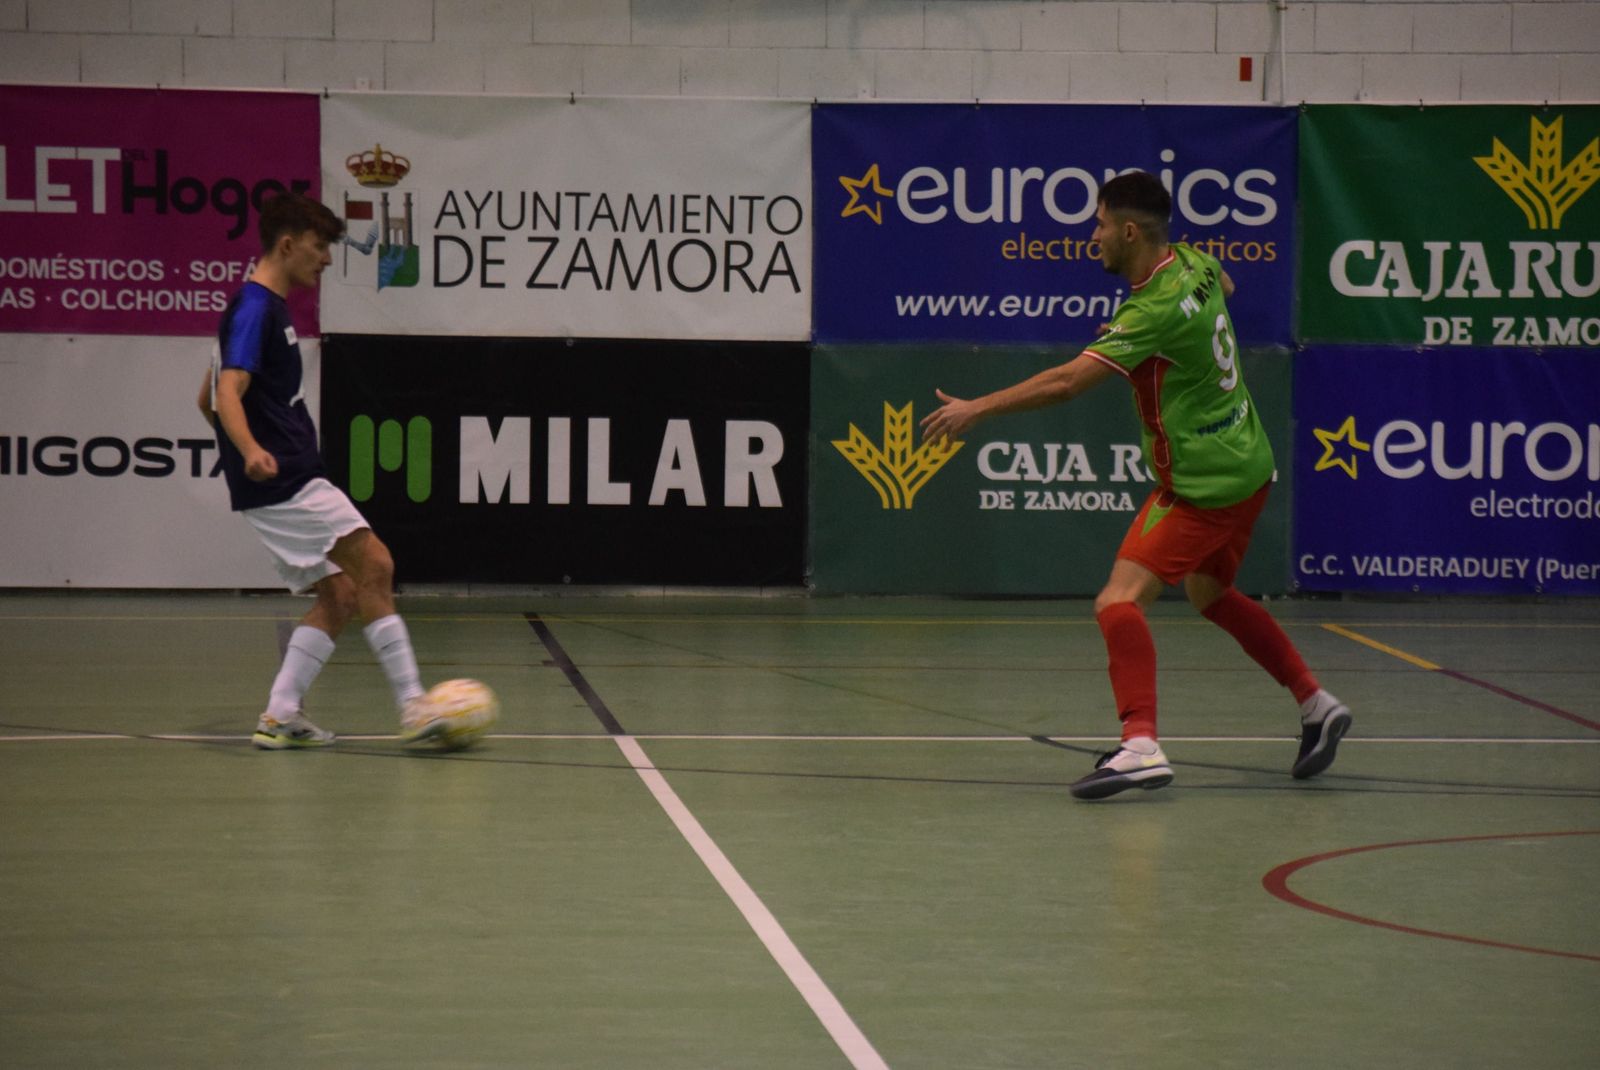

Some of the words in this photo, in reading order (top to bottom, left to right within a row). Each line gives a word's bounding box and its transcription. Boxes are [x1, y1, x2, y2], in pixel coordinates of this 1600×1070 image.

[0, 145, 121, 214] LET
[897, 149, 1278, 226] euroics
[434, 190, 804, 235] AYUNTAMIENTO
[433, 235, 506, 290] DE
[526, 236, 802, 294] ZAMORA
[1329, 240, 1502, 302] CAJA
[1508, 241, 1600, 299] RU
[61, 287, 228, 313] COLCHONES
[1212, 314, 1239, 391] 9
[1424, 317, 1473, 345] DE
[1492, 317, 1600, 346] ZAMO
[0, 436, 224, 477] IGOST
[459, 416, 785, 508] MILAR
[977, 442, 1098, 484] CAJA
[1373, 420, 1600, 482] euro
[979, 491, 1015, 510] DE
[1024, 491, 1136, 512] ZAMORA
[1299, 554, 1344, 576] C.C.
[1352, 555, 1530, 579] VALDERADUEY
